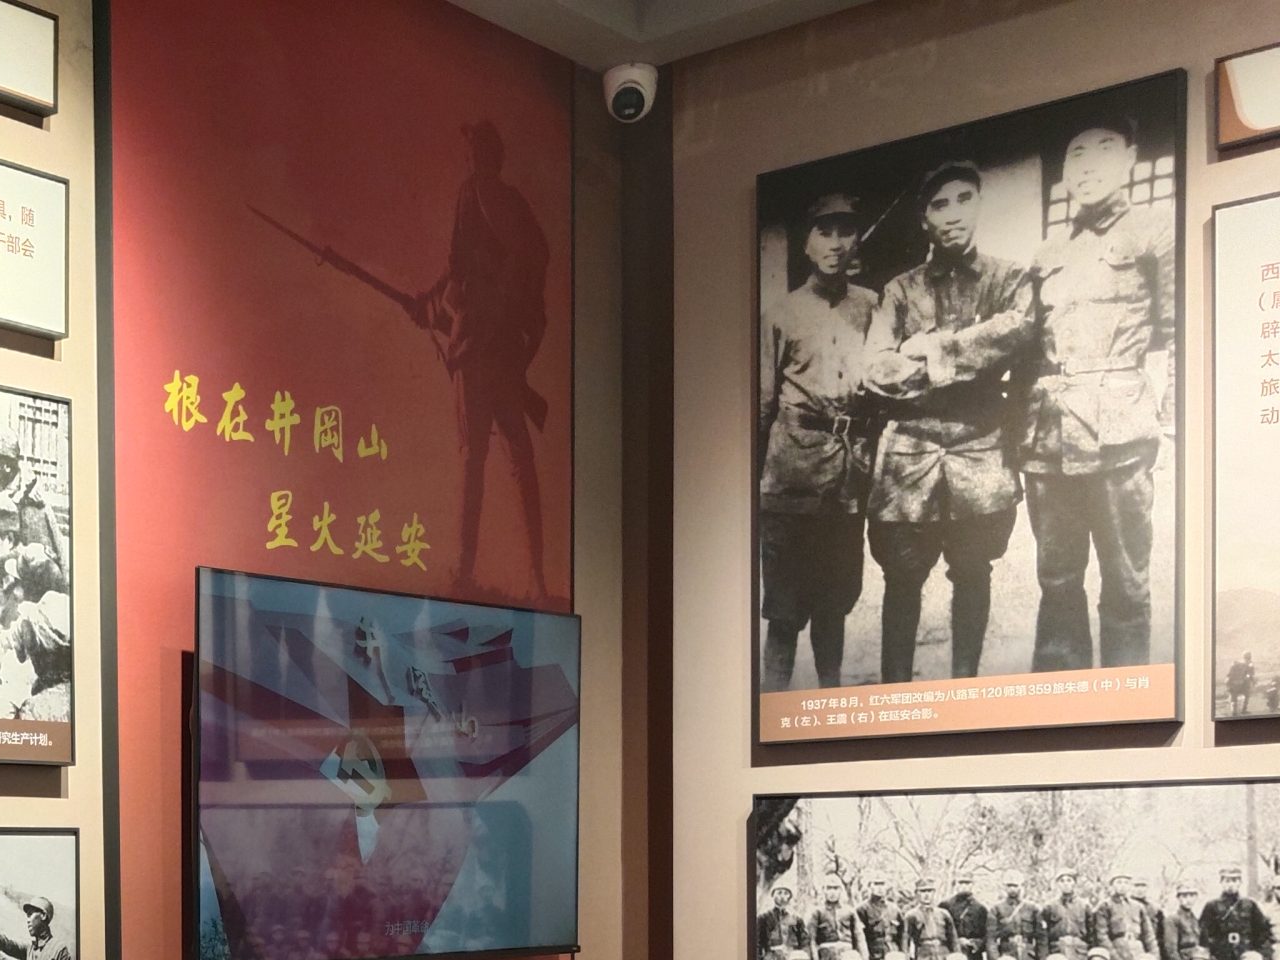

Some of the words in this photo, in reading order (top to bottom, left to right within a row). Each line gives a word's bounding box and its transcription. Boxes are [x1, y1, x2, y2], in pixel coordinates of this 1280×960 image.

[1260, 349, 1280, 369] 太
[1260, 378, 1280, 398] 旅
[1260, 406, 1280, 425] 动
[265, 490, 431, 572] 星火延安
